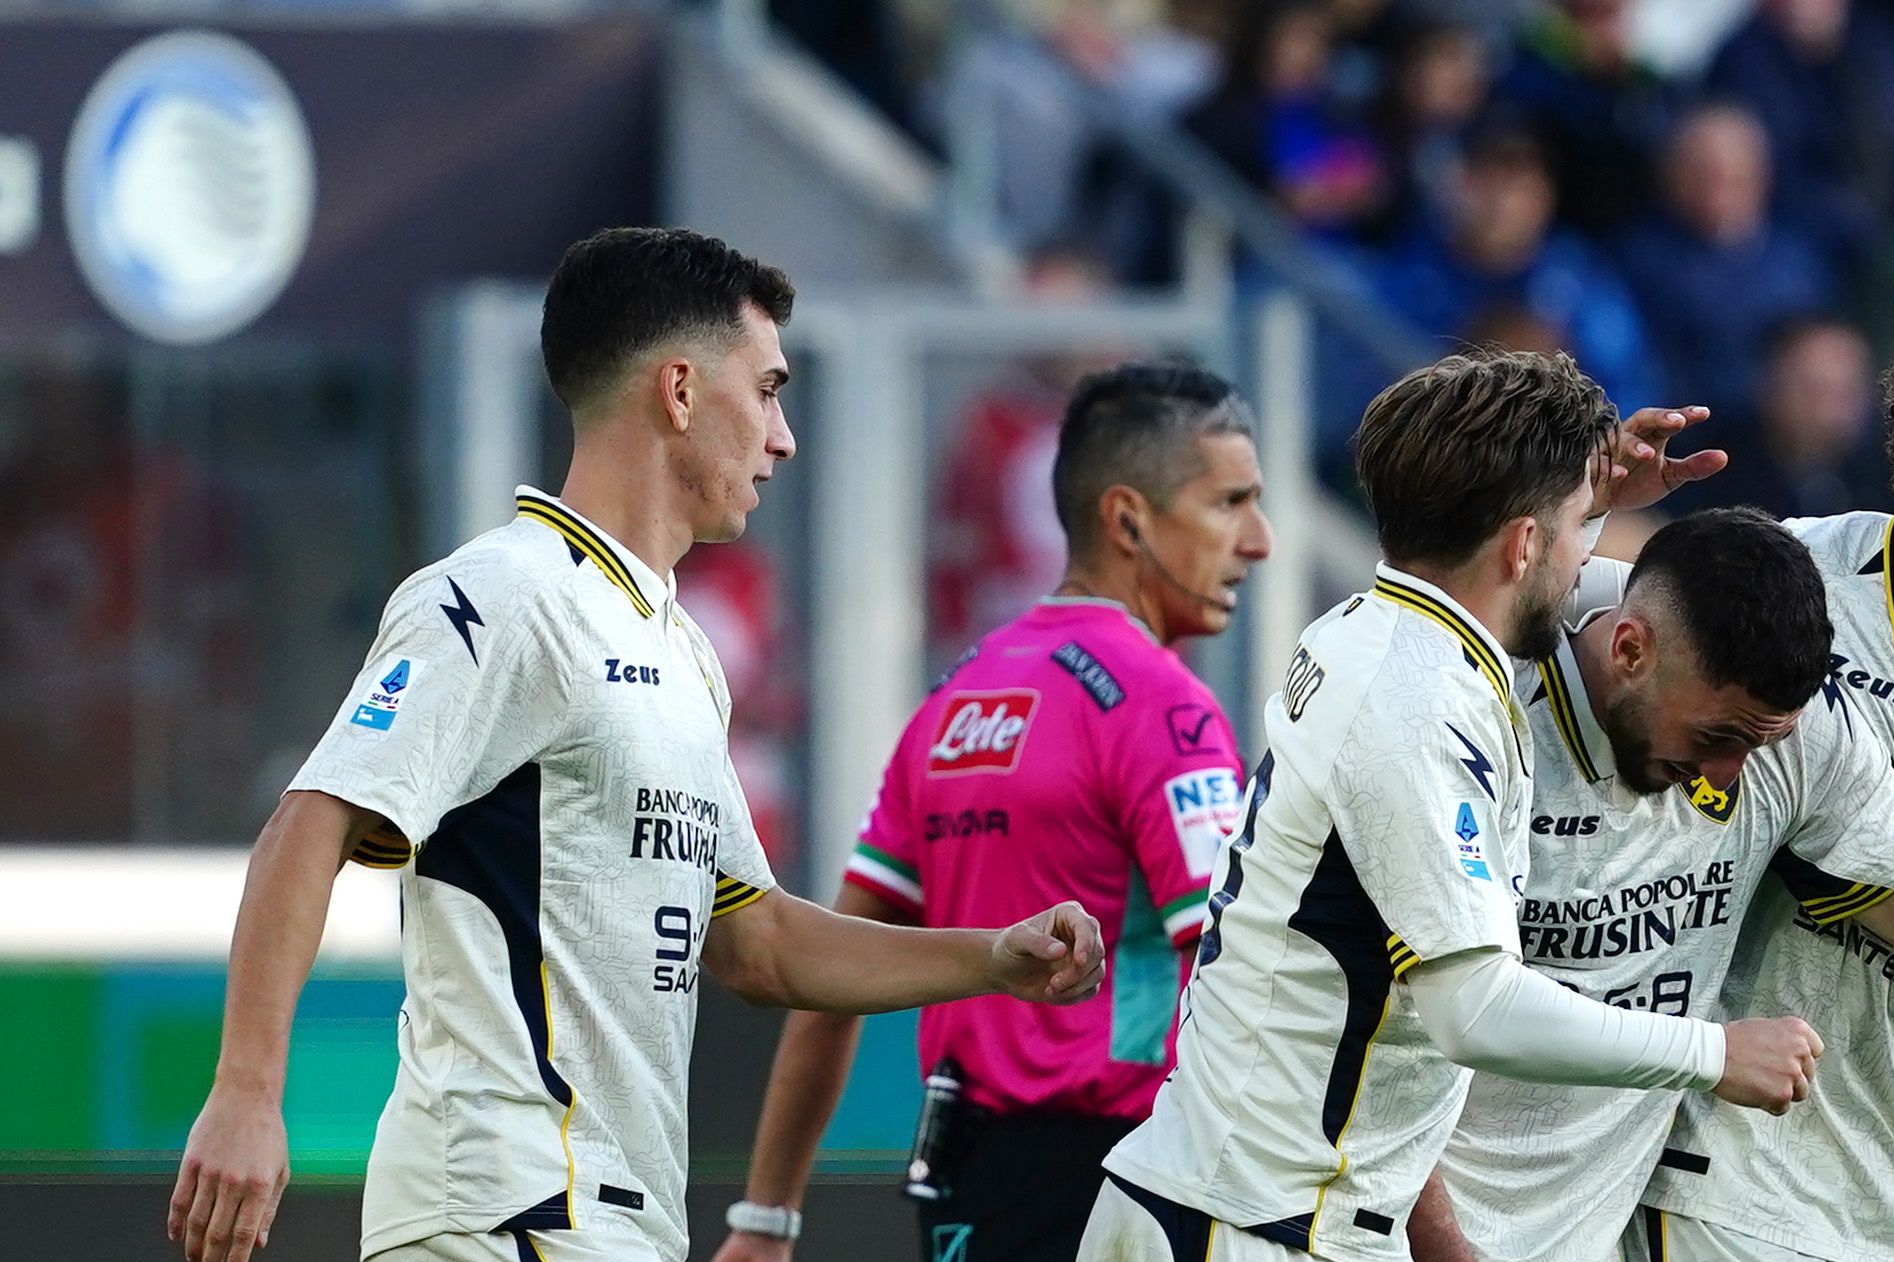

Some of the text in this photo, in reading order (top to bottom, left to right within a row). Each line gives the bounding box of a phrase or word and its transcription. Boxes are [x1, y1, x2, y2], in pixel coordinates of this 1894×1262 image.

[605, 659, 660, 686] Zeus
[1531, 813, 1600, 837] eus
[1522, 894, 1616, 925] BANCA
